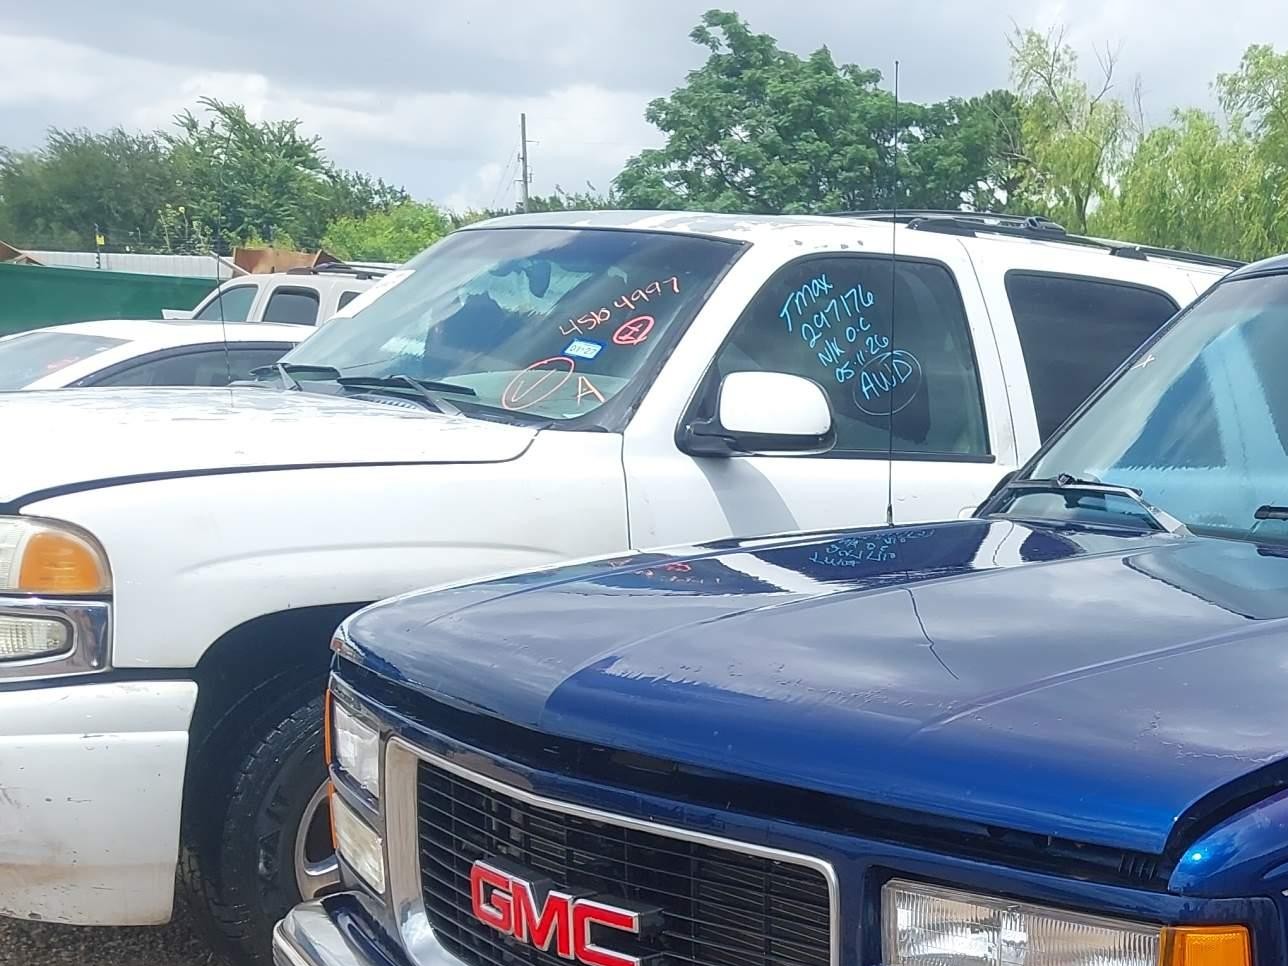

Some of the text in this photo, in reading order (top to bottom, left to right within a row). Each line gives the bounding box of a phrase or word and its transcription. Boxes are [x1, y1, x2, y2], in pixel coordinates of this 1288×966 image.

[801, 284, 874, 349] 297176
[576, 375, 606, 406] A
[860, 359, 913, 401] AWD
